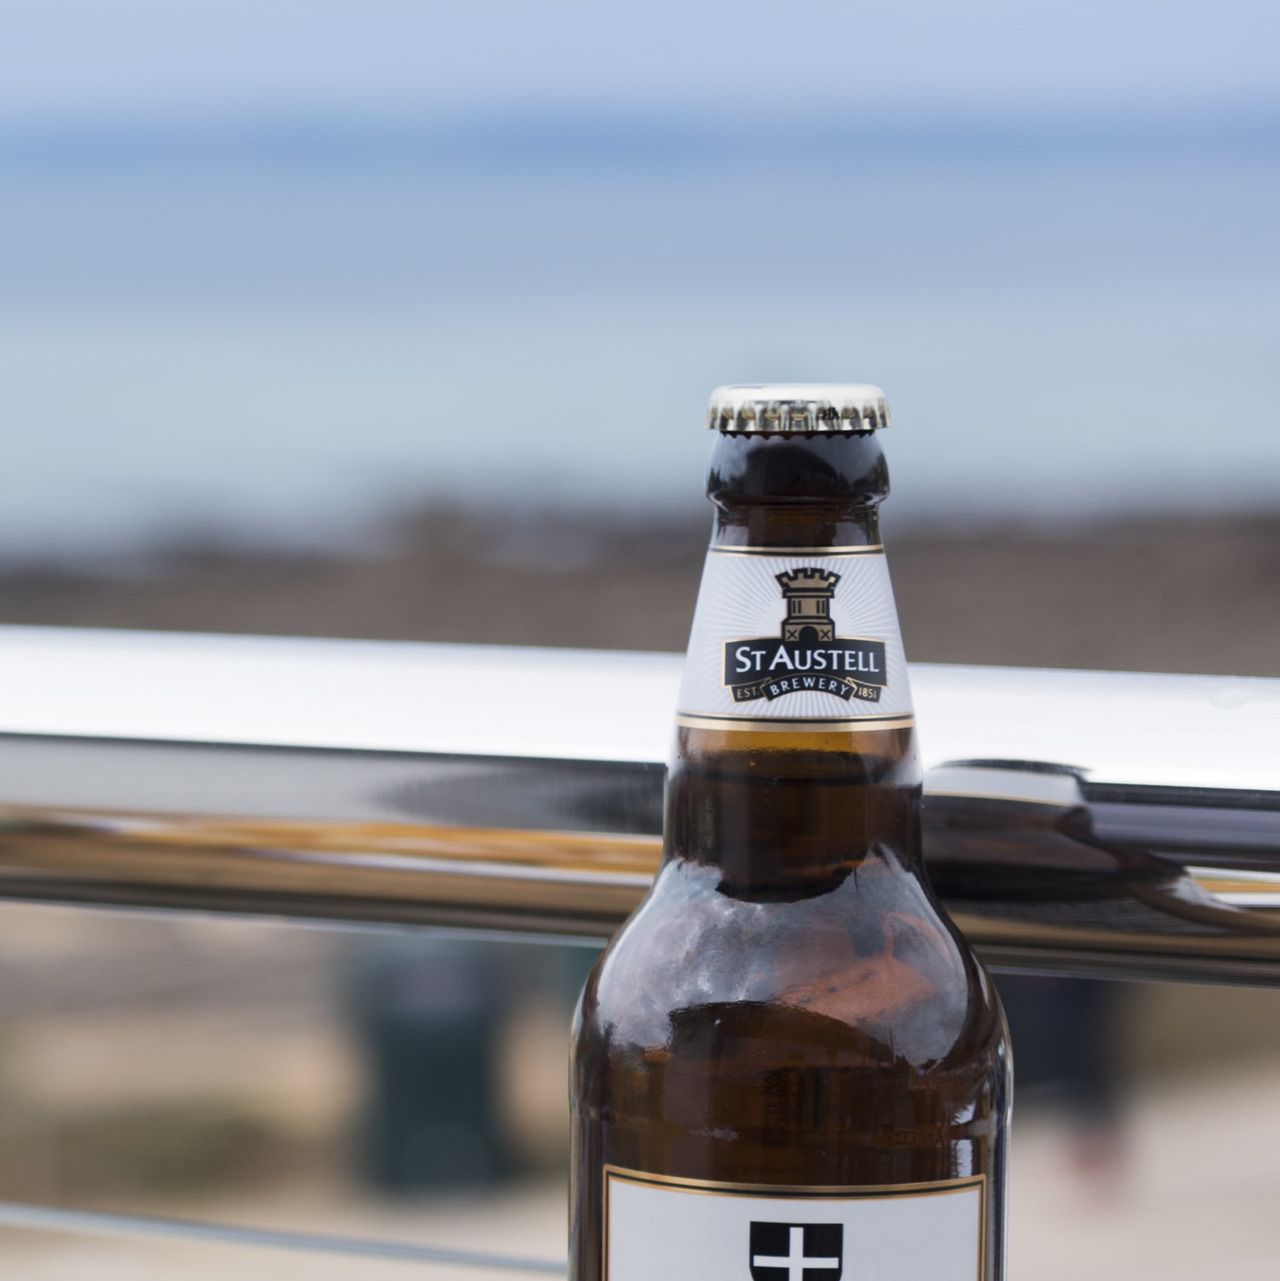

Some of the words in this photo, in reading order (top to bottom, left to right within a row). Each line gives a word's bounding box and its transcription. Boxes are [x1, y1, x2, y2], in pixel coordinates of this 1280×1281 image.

[768, 644, 880, 673] AUSTELL
[736, 686, 760, 699] EST.
[769, 676, 850, 697] BREWERY
[858, 687, 878, 699] 1851
